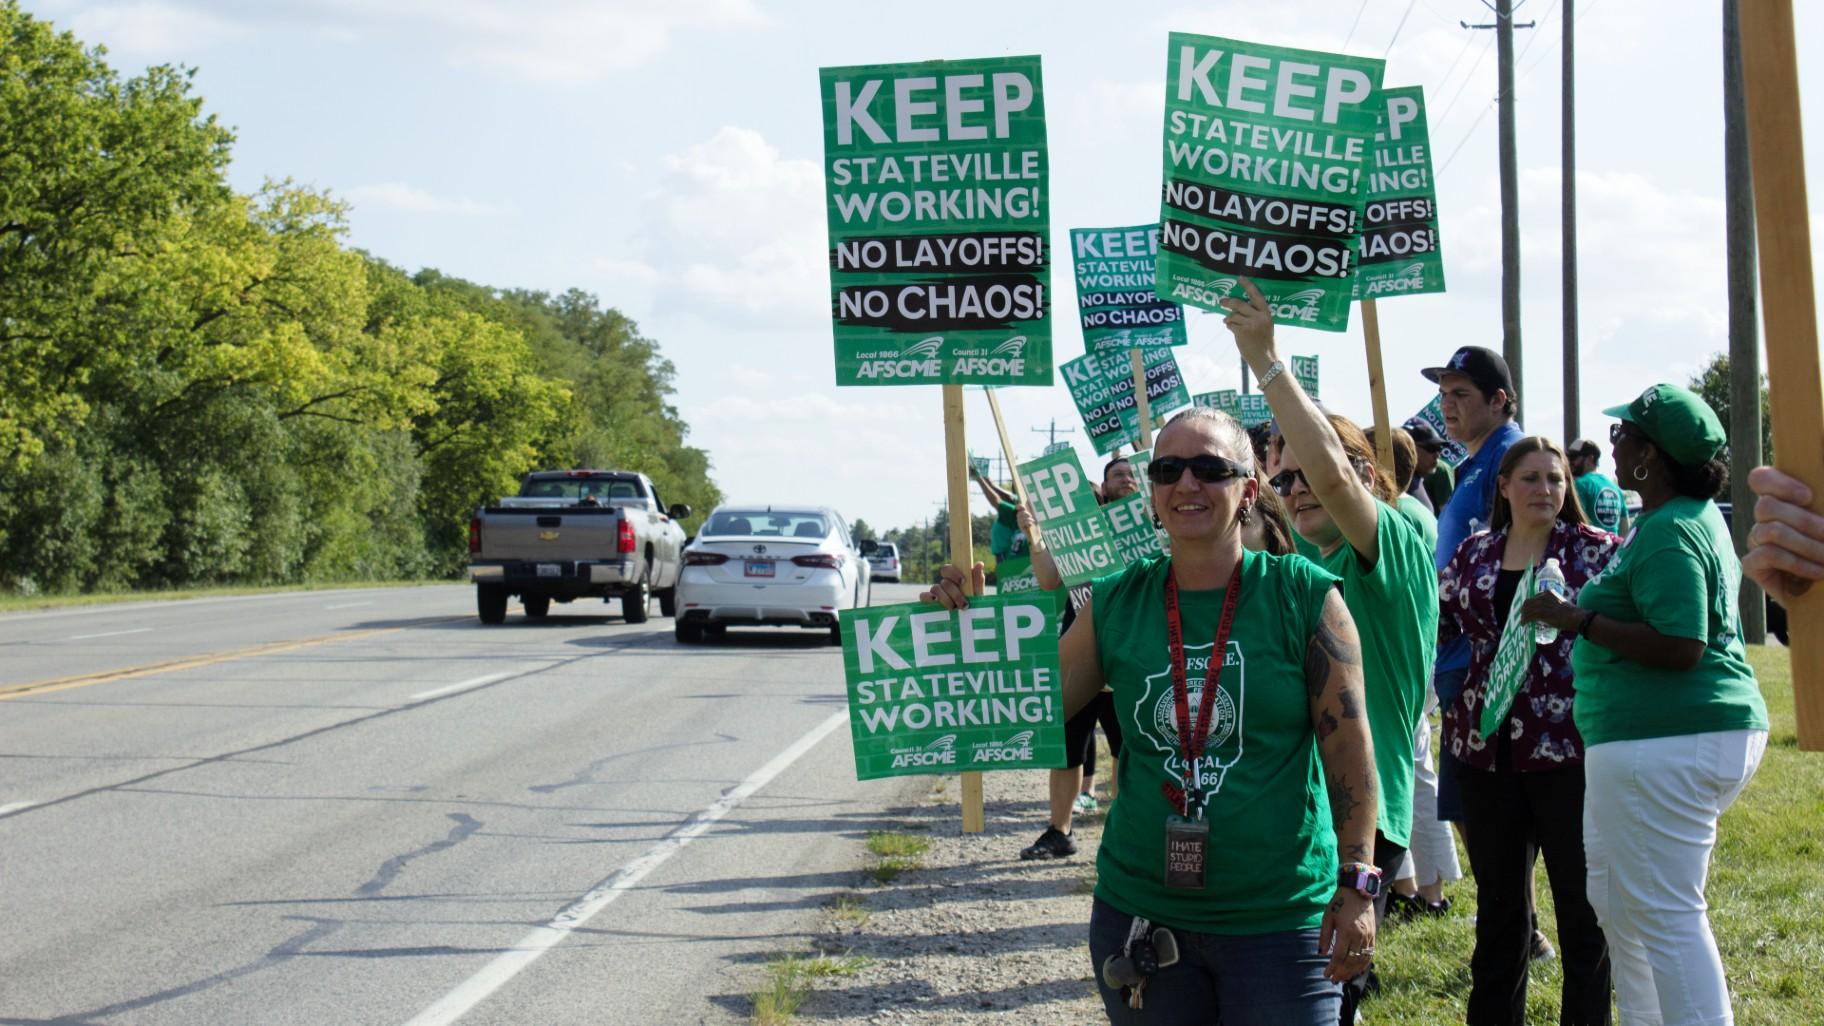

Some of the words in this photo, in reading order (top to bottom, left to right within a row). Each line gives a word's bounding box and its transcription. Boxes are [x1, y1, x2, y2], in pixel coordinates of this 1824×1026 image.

[1177, 46, 1371, 124] KEEP
[835, 72, 1034, 145] KEEP
[1170, 111, 1364, 162] STATEVILLE
[832, 152, 1039, 185] STATEVILLE
[1168, 139, 1360, 194] WORKING!
[833, 187, 1039, 223] WORKING!
[1166, 181, 1203, 210] NO
[1208, 191, 1356, 234] LAYOFFS!
[1366, 200, 1432, 222] OFFS!
[838, 241, 887, 269] NO
[896, 237, 1042, 267] LAYOFFS!
[1163, 222, 1200, 250] NO
[1205, 232, 1350, 278] CHAOS!
[1079, 273, 1156, 288] WORKIN
[1365, 277, 1424, 294] AFSCME
[839, 291, 888, 318] NO
[898, 285, 1043, 319] CHAOS!
[1080, 293, 1104, 308] NO
[1172, 284, 1232, 311] AFSCM
[1084, 313, 1106, 328] NO
[1110, 307, 1180, 324] CHAOS!
[856, 351, 876, 359] Local
[952, 348, 982, 357] Council
[856, 360, 942, 378] AFSCME
[952, 358, 1024, 376] AFSCME
[1065, 356, 1101, 387] KE
[1111, 382, 1127, 396] NO
[1116, 396, 1133, 410] NO
[1085, 409, 1102, 422] NO
[1091, 423, 1108, 437] NO
[1021, 462, 1079, 522] EEP
[853, 604, 1045, 674] KEEP
[857, 668, 1050, 704] STATEVILLE
[859, 696, 1053, 734] WORKING!
[891, 750, 956, 768] AFSCME
[972, 748, 1033, 762] AFSCME
[1176, 841, 1202, 852] HATE
[1170, 853, 1202, 862] STUPID
[1170, 862, 1202, 872] PEOPLE
